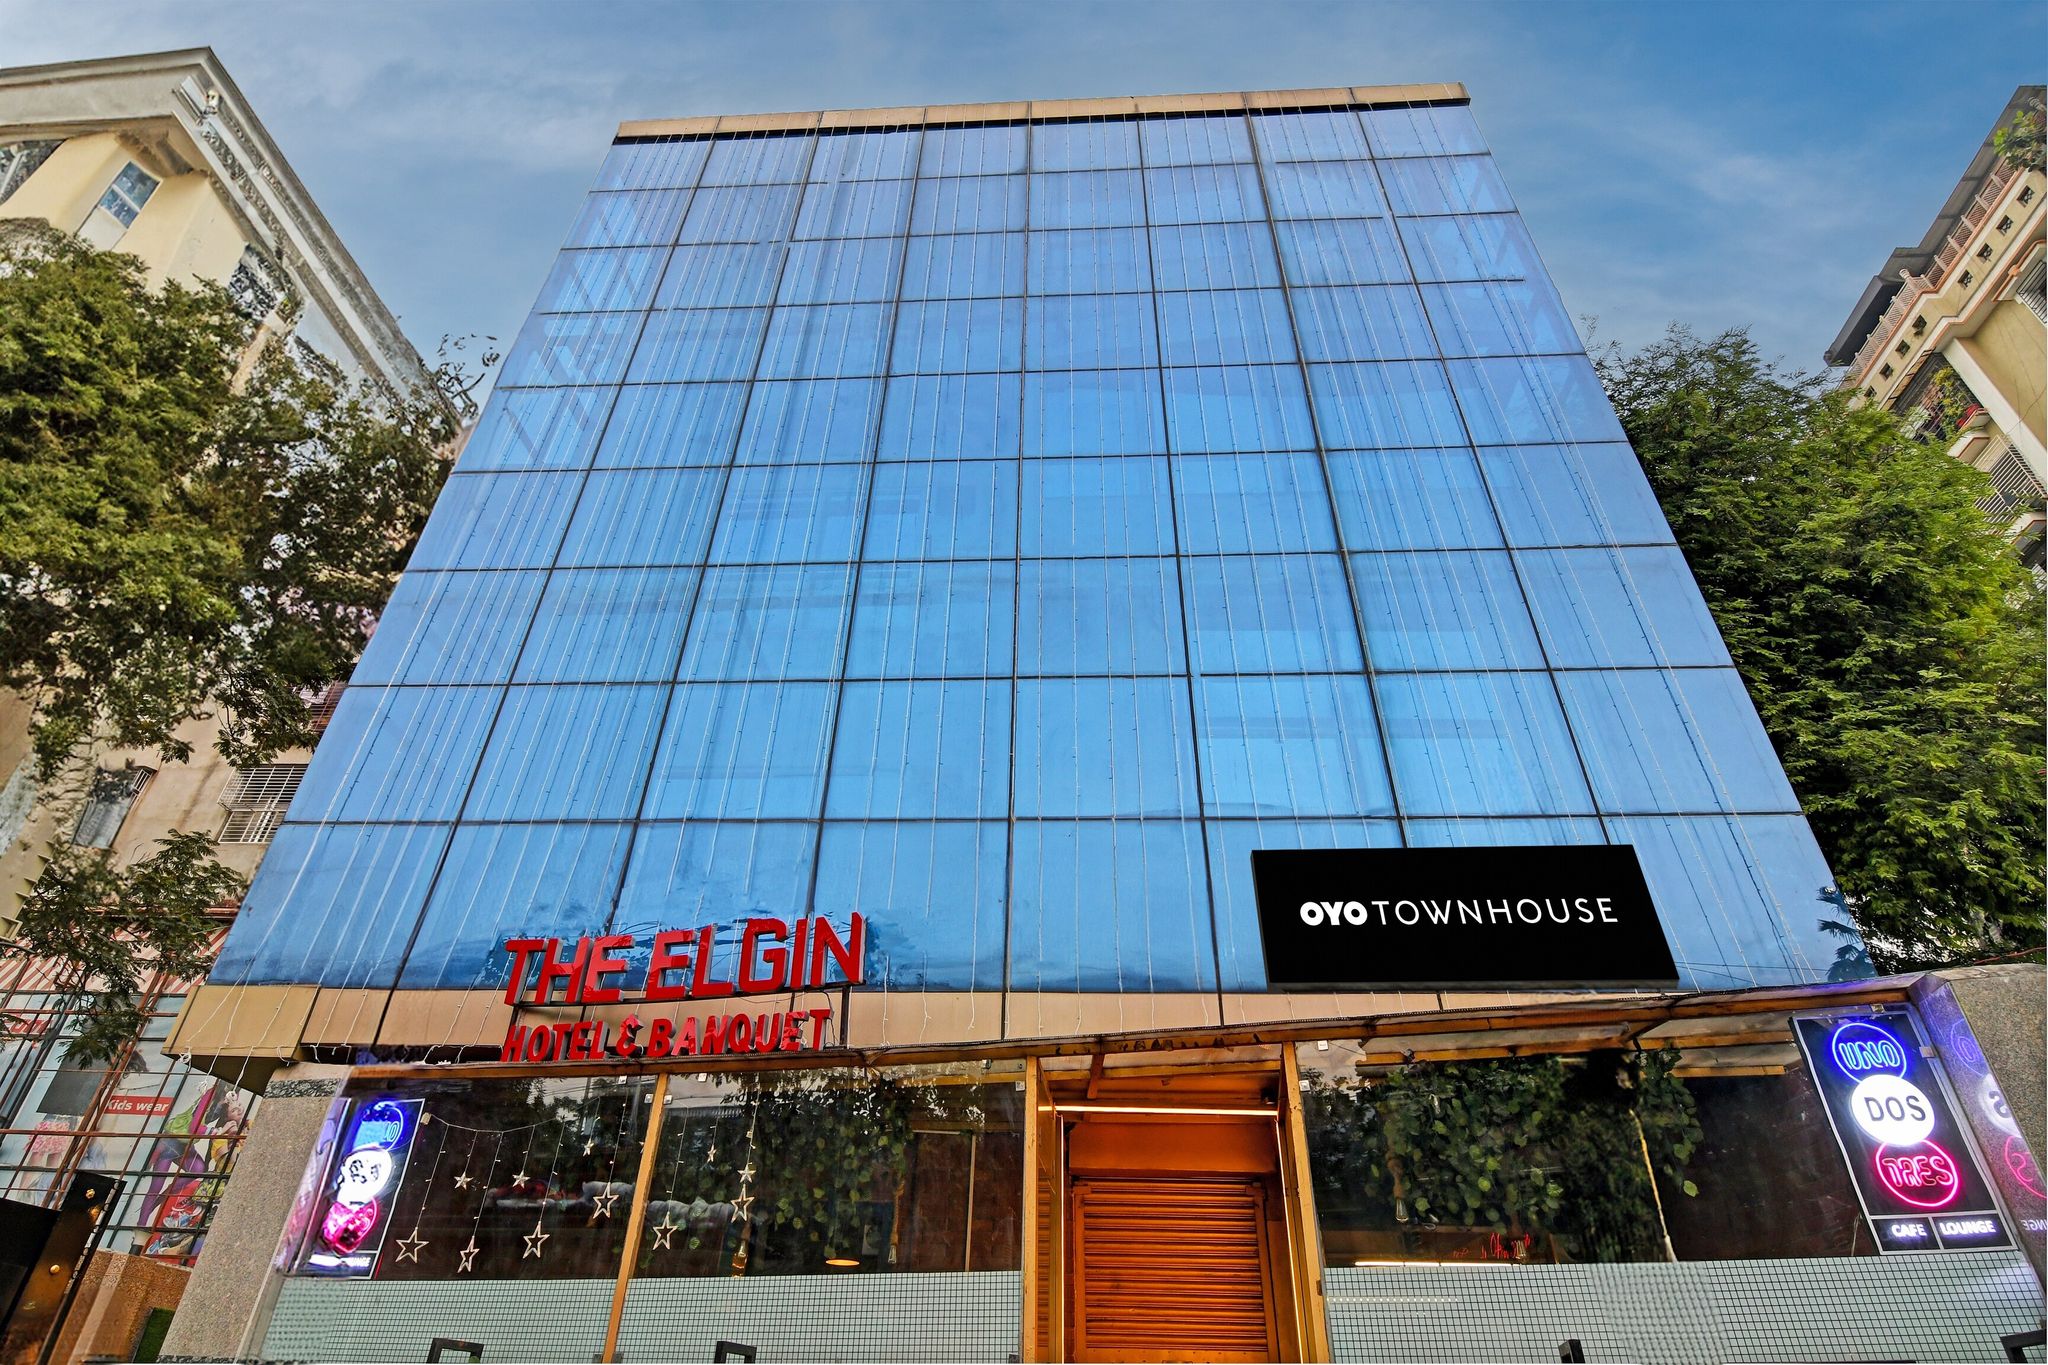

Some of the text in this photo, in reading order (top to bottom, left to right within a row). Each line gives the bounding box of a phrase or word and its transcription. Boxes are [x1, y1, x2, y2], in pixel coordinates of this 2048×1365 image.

[1300, 898, 1618, 926] OYO TOWNHOUSE
[504, 912, 865, 1006] THE ELGIN
[501, 1008, 834, 1062] HOTEL & BANQUET
[1838, 1040, 1901, 1070] UNO
[107, 1099, 170, 1112] Kids wear
[1864, 1095, 1926, 1122] DOS
[1882, 1156, 1954, 1187] TRES
[1891, 1220, 1996, 1237] CAFE LOUNGE
